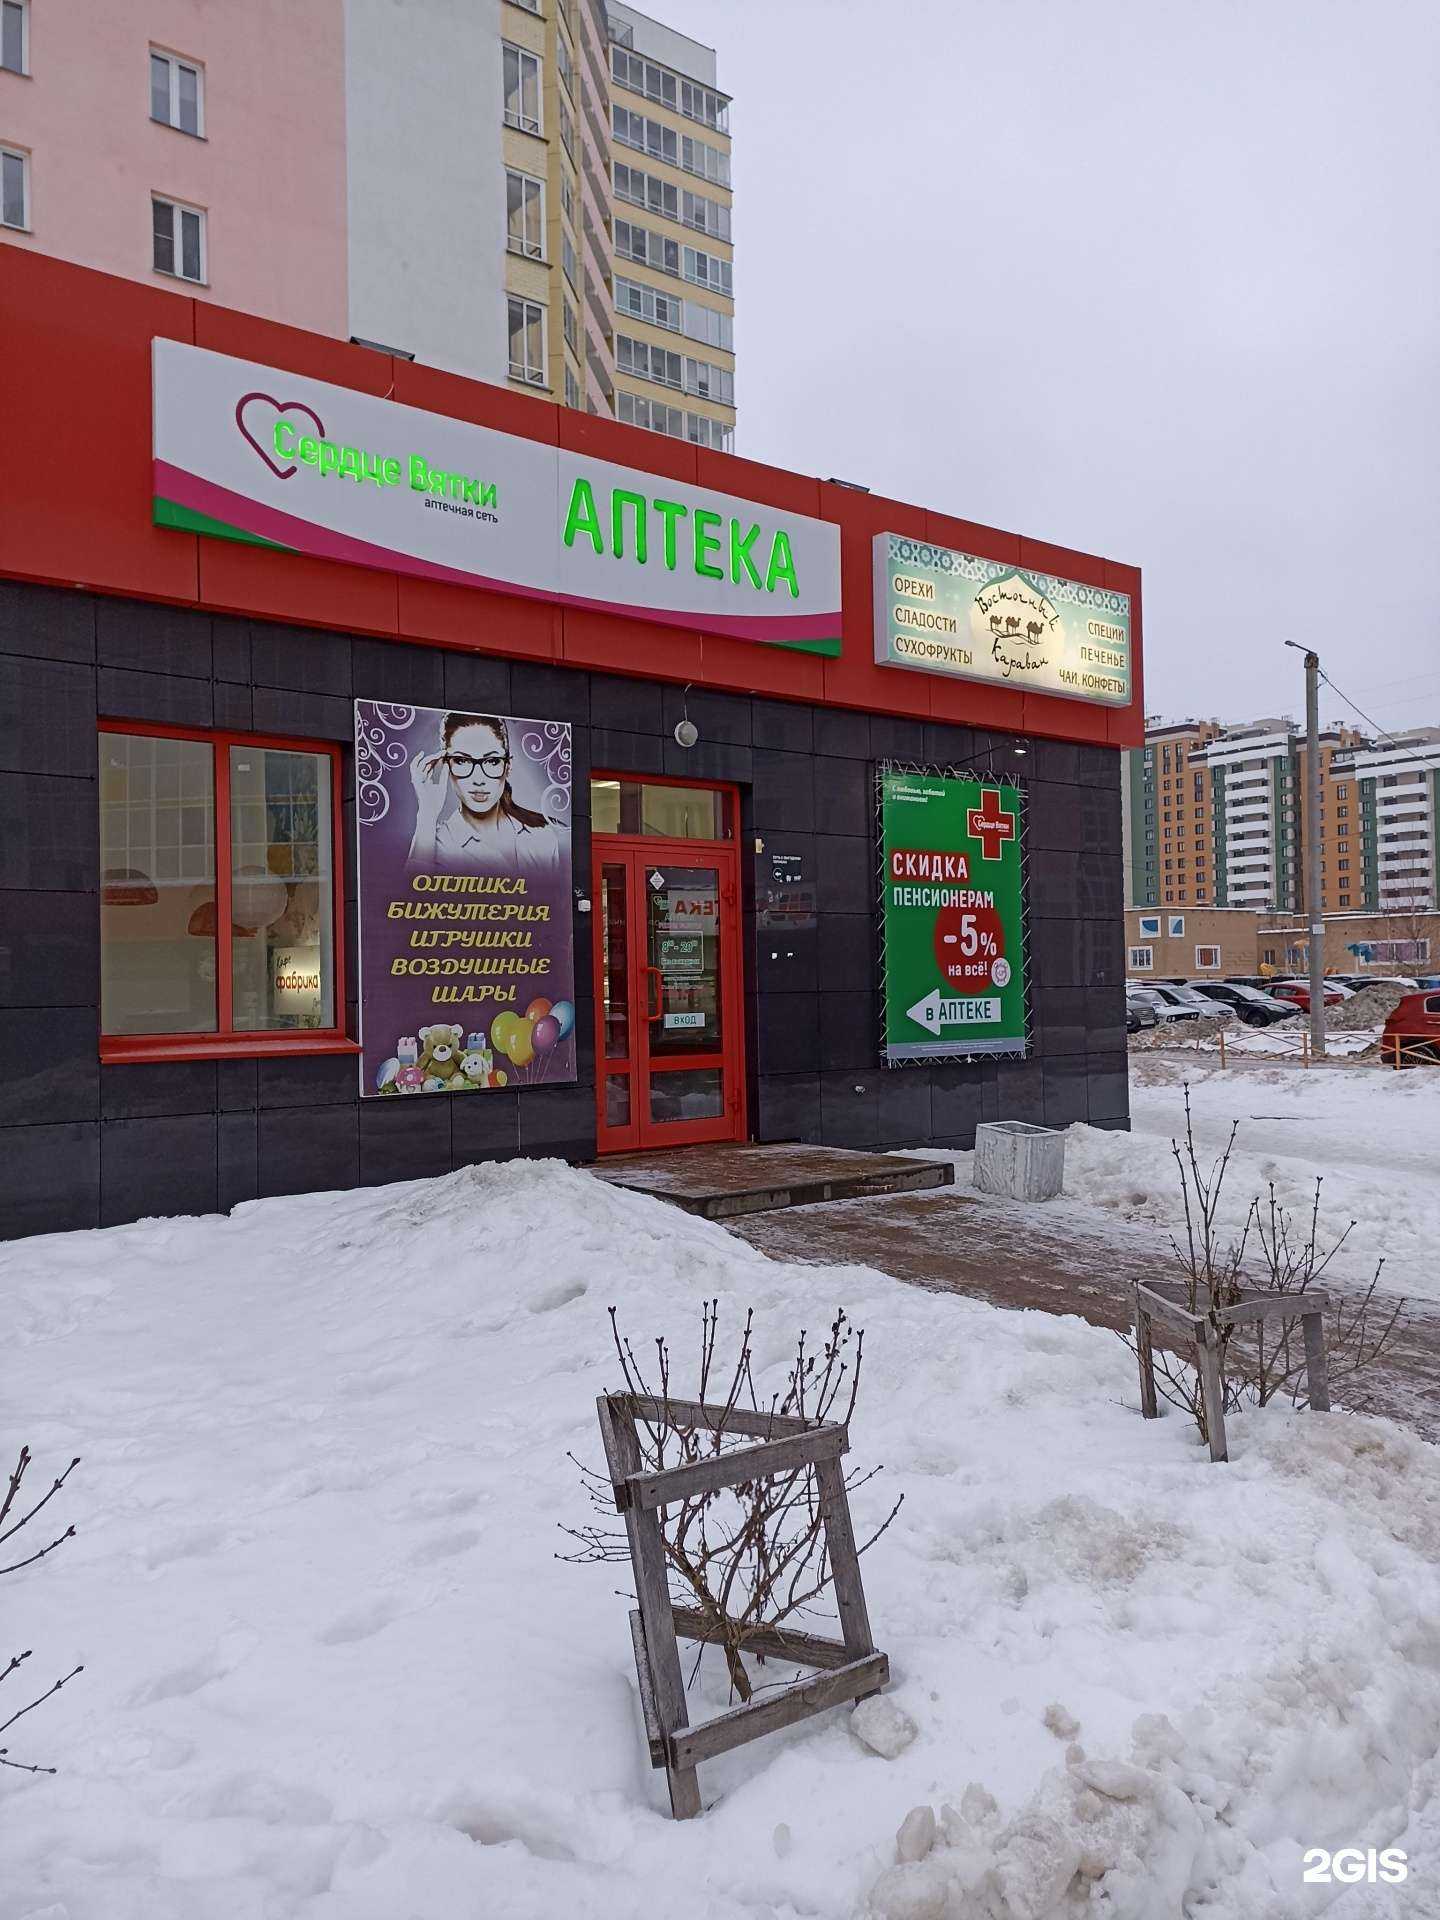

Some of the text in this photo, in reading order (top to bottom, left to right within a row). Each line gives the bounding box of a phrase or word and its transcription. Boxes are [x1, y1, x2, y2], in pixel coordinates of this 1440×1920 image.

[273, 421, 498, 509] Сердце Вятки
[424, 498, 499, 524] аптечная сеть
[563, 477, 800, 599] АПТЕКА
[894, 577, 934, 600] ОРЕХИ
[895, 607, 957, 633] СЛАДОСТИ
[1088, 622, 1125, 642] СПЕЦИИ
[895, 637, 973, 665] СУХОФРУКТЫ
[992, 637, 1049, 678] Караван
[1080, 646, 1125, 668] ПЕЧЕНЬЕ
[1082, 673, 1125, 694] КОНФЕТЫ
[893, 852, 968, 882] СКИДКА
[412, 874, 528, 895] ОПТИКА
[893, 886, 994, 909] ПЕНСИОНЕРАМ
[387, 901, 551, 922] БИЖУТЕРИЯ
[410, 930, 533, 948] ИГРУШКИ
[391, 958, 551, 976] ВОЗДУШНЫЕ
[948, 961, 988, 977] на всё!
[276, 970, 319, 994] фабрика
[431, 985, 517, 1003] ШАРЫ
[674, 1015, 697, 1025] ВХОД
[939, 1000, 992, 1021] АПТЕКЕ
